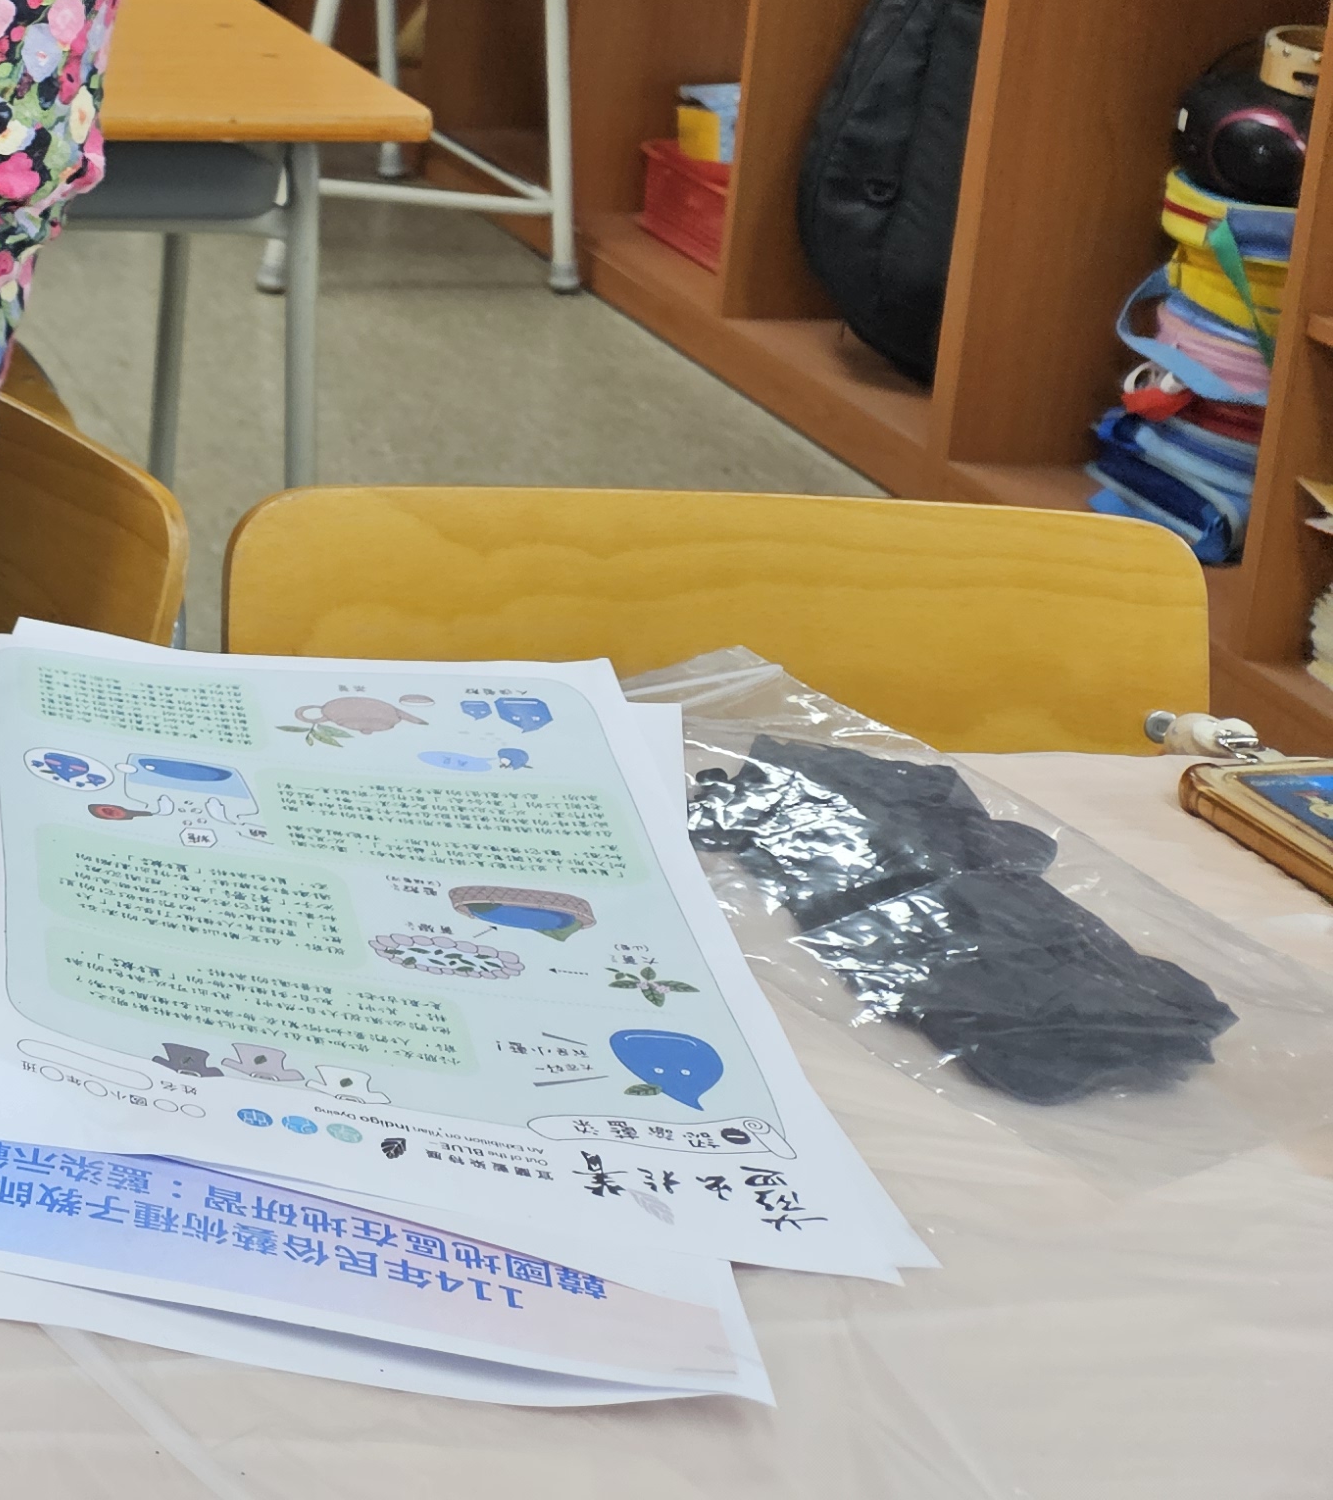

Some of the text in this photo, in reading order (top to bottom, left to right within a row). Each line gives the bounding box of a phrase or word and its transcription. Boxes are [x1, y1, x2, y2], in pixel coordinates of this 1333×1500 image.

[160, 1080, 198, 1096] 姓名
[313, 1106, 544, 1155] An Exhibition on Yilan Indigo Dyeing
[487, 1150, 507, 1161] the
[509, 1154, 522, 1164] of
[524, 1156, 548, 1167] Out
